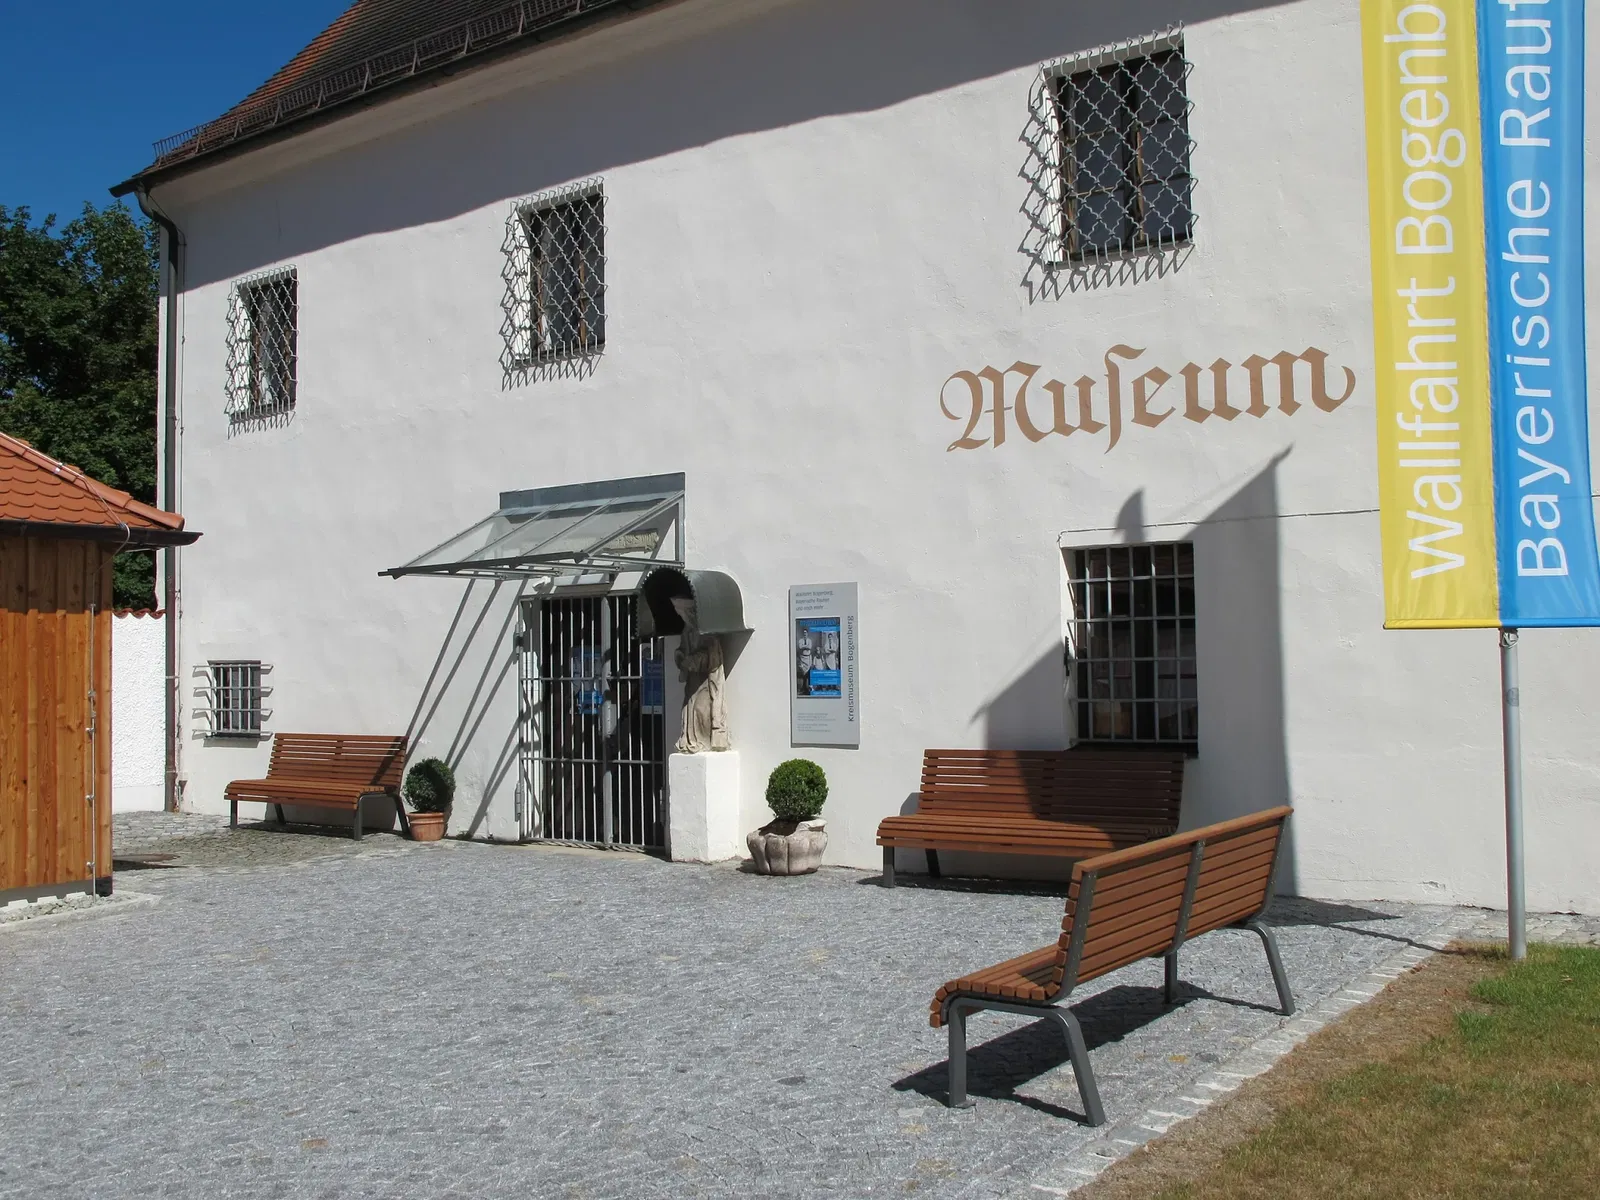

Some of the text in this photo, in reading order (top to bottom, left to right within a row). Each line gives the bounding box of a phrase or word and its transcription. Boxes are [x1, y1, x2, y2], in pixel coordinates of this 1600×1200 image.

[1384, 4, 1466, 579] Wallfahrt Bogenb
[1502, 179, 1571, 577] Bayerische
[847, 615, 855, 661] Bogenberg
